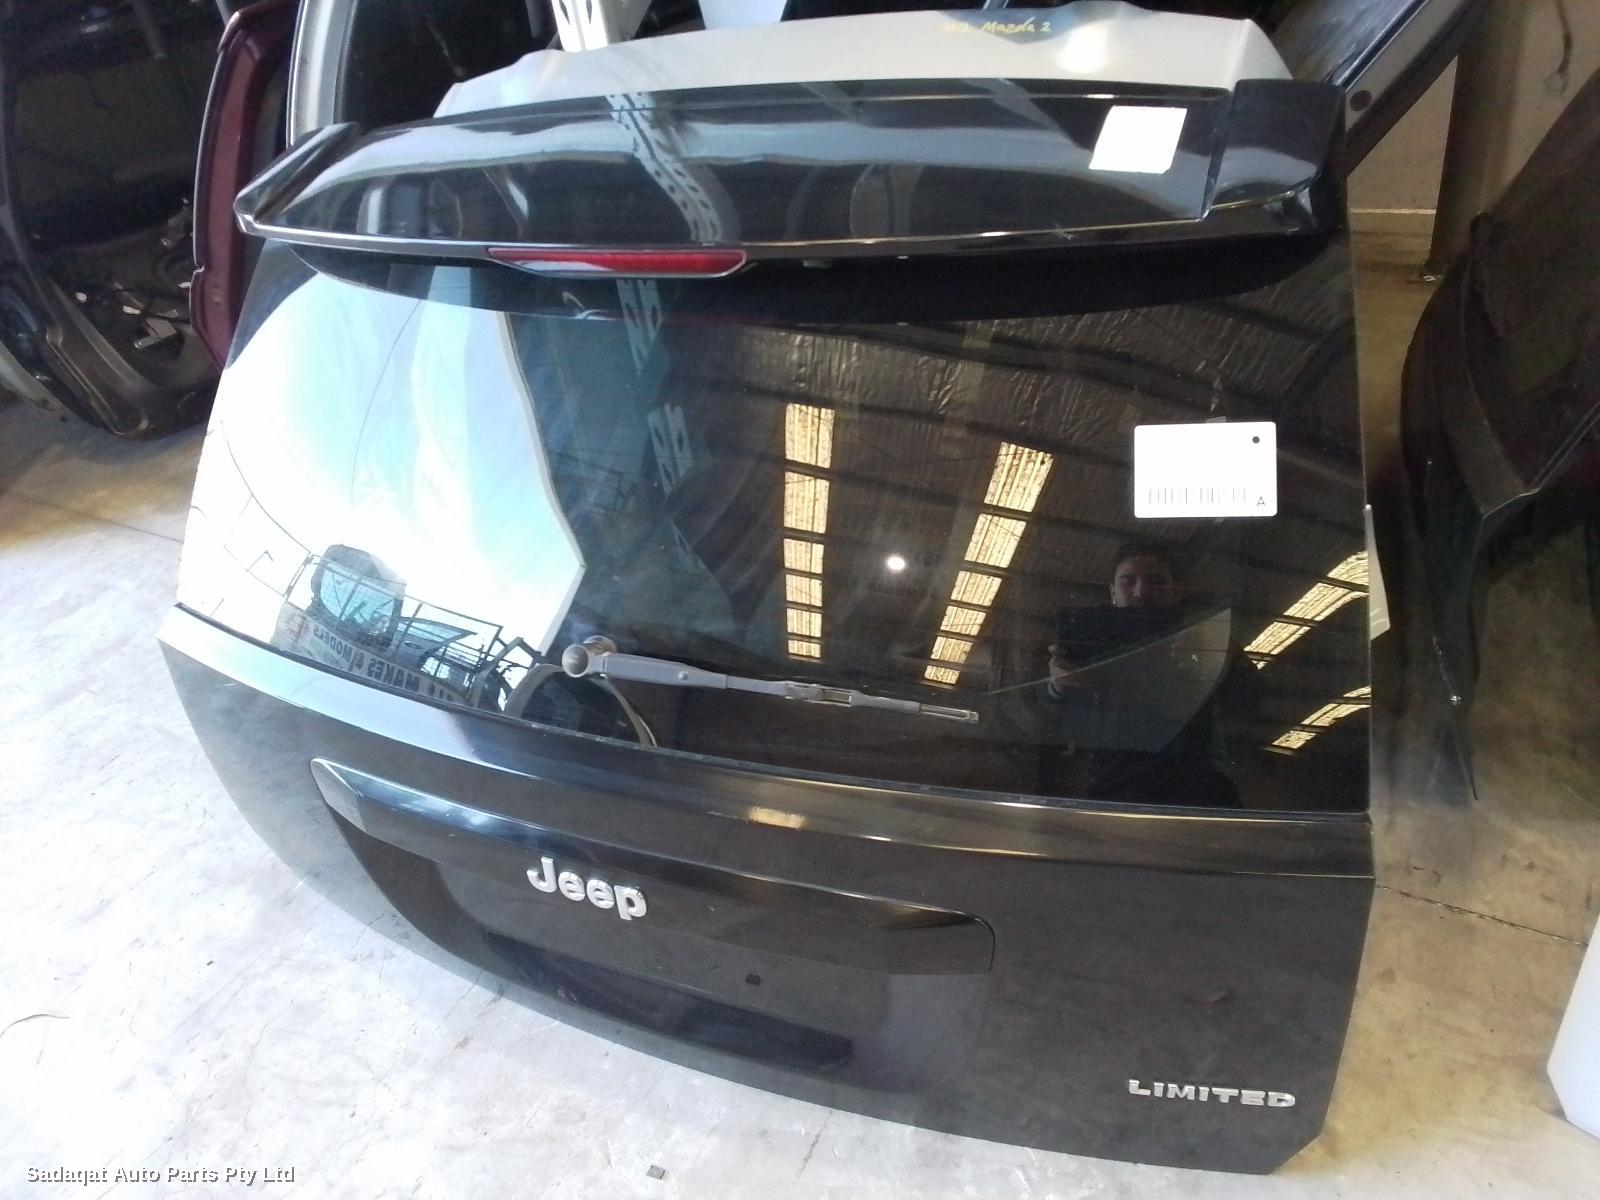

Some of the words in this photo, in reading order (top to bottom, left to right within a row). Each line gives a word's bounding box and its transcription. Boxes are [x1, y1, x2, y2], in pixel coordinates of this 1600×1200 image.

[1040, 20, 1052, 33] 2
[1256, 495, 1267, 508] A
[526, 855, 648, 921] Jeep
[1128, 1078, 1297, 1108] LIMITED
